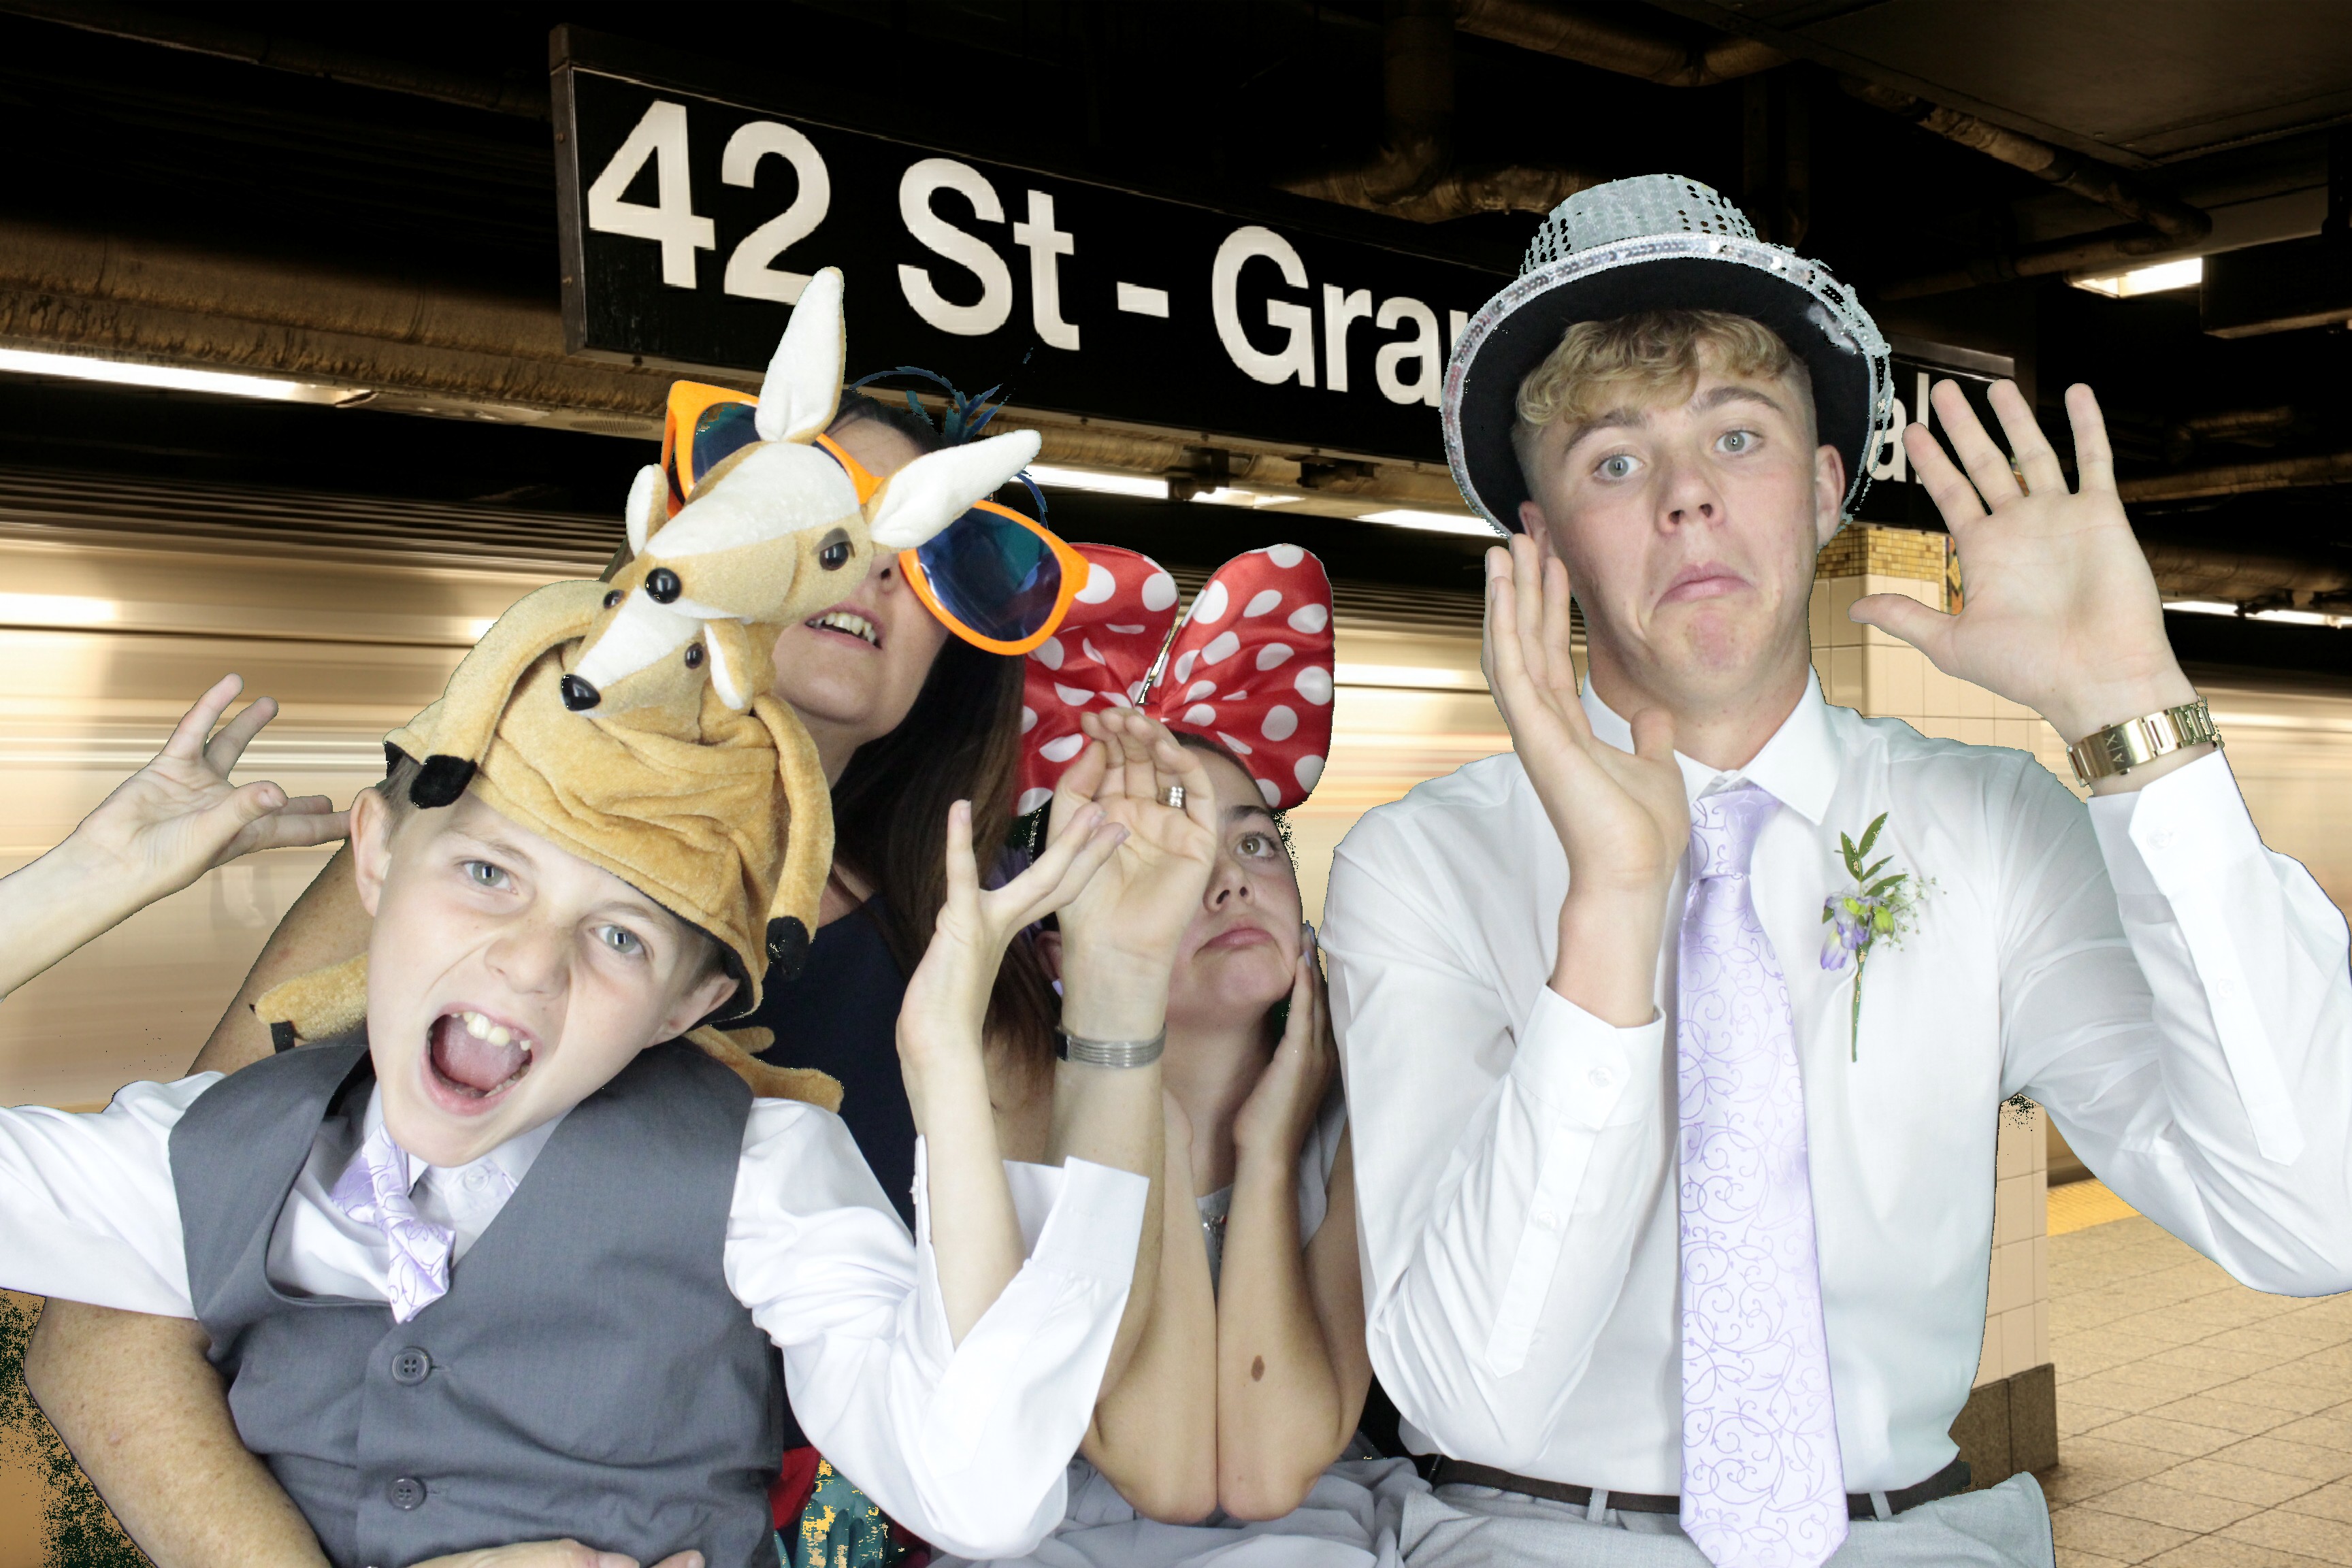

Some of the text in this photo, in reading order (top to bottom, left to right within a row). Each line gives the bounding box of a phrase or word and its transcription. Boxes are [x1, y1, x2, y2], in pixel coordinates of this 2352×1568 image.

[588, 100, 831, 306] 42
[898, 158, 1080, 351] St
[1117, 281, 1169, 318] -
[1211, 225, 1468, 408] Gra
